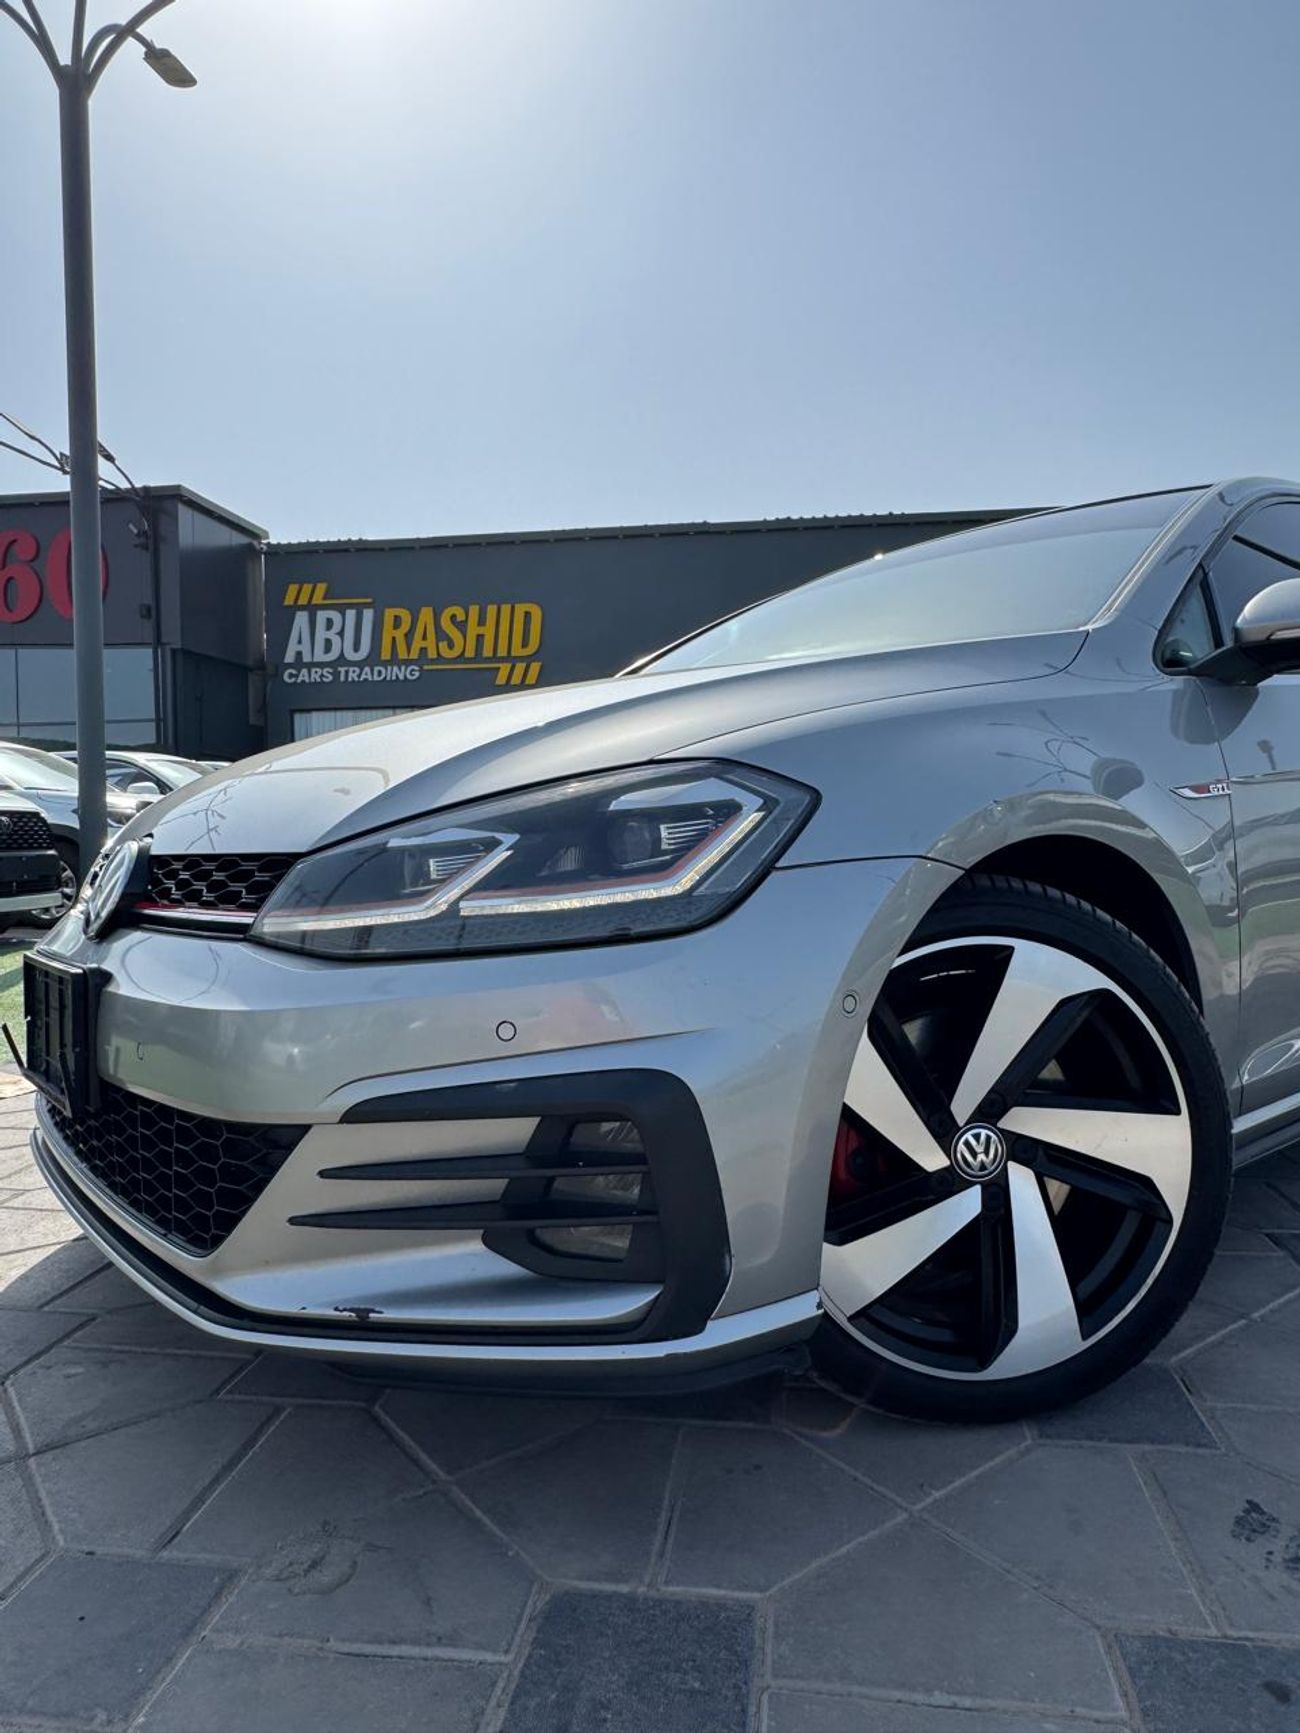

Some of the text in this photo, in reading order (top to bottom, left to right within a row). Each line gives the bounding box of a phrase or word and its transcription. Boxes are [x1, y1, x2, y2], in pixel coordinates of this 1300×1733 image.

[284, 603, 543, 663] ABU RASHID
[283, 665, 421, 684] CARS TRADING
